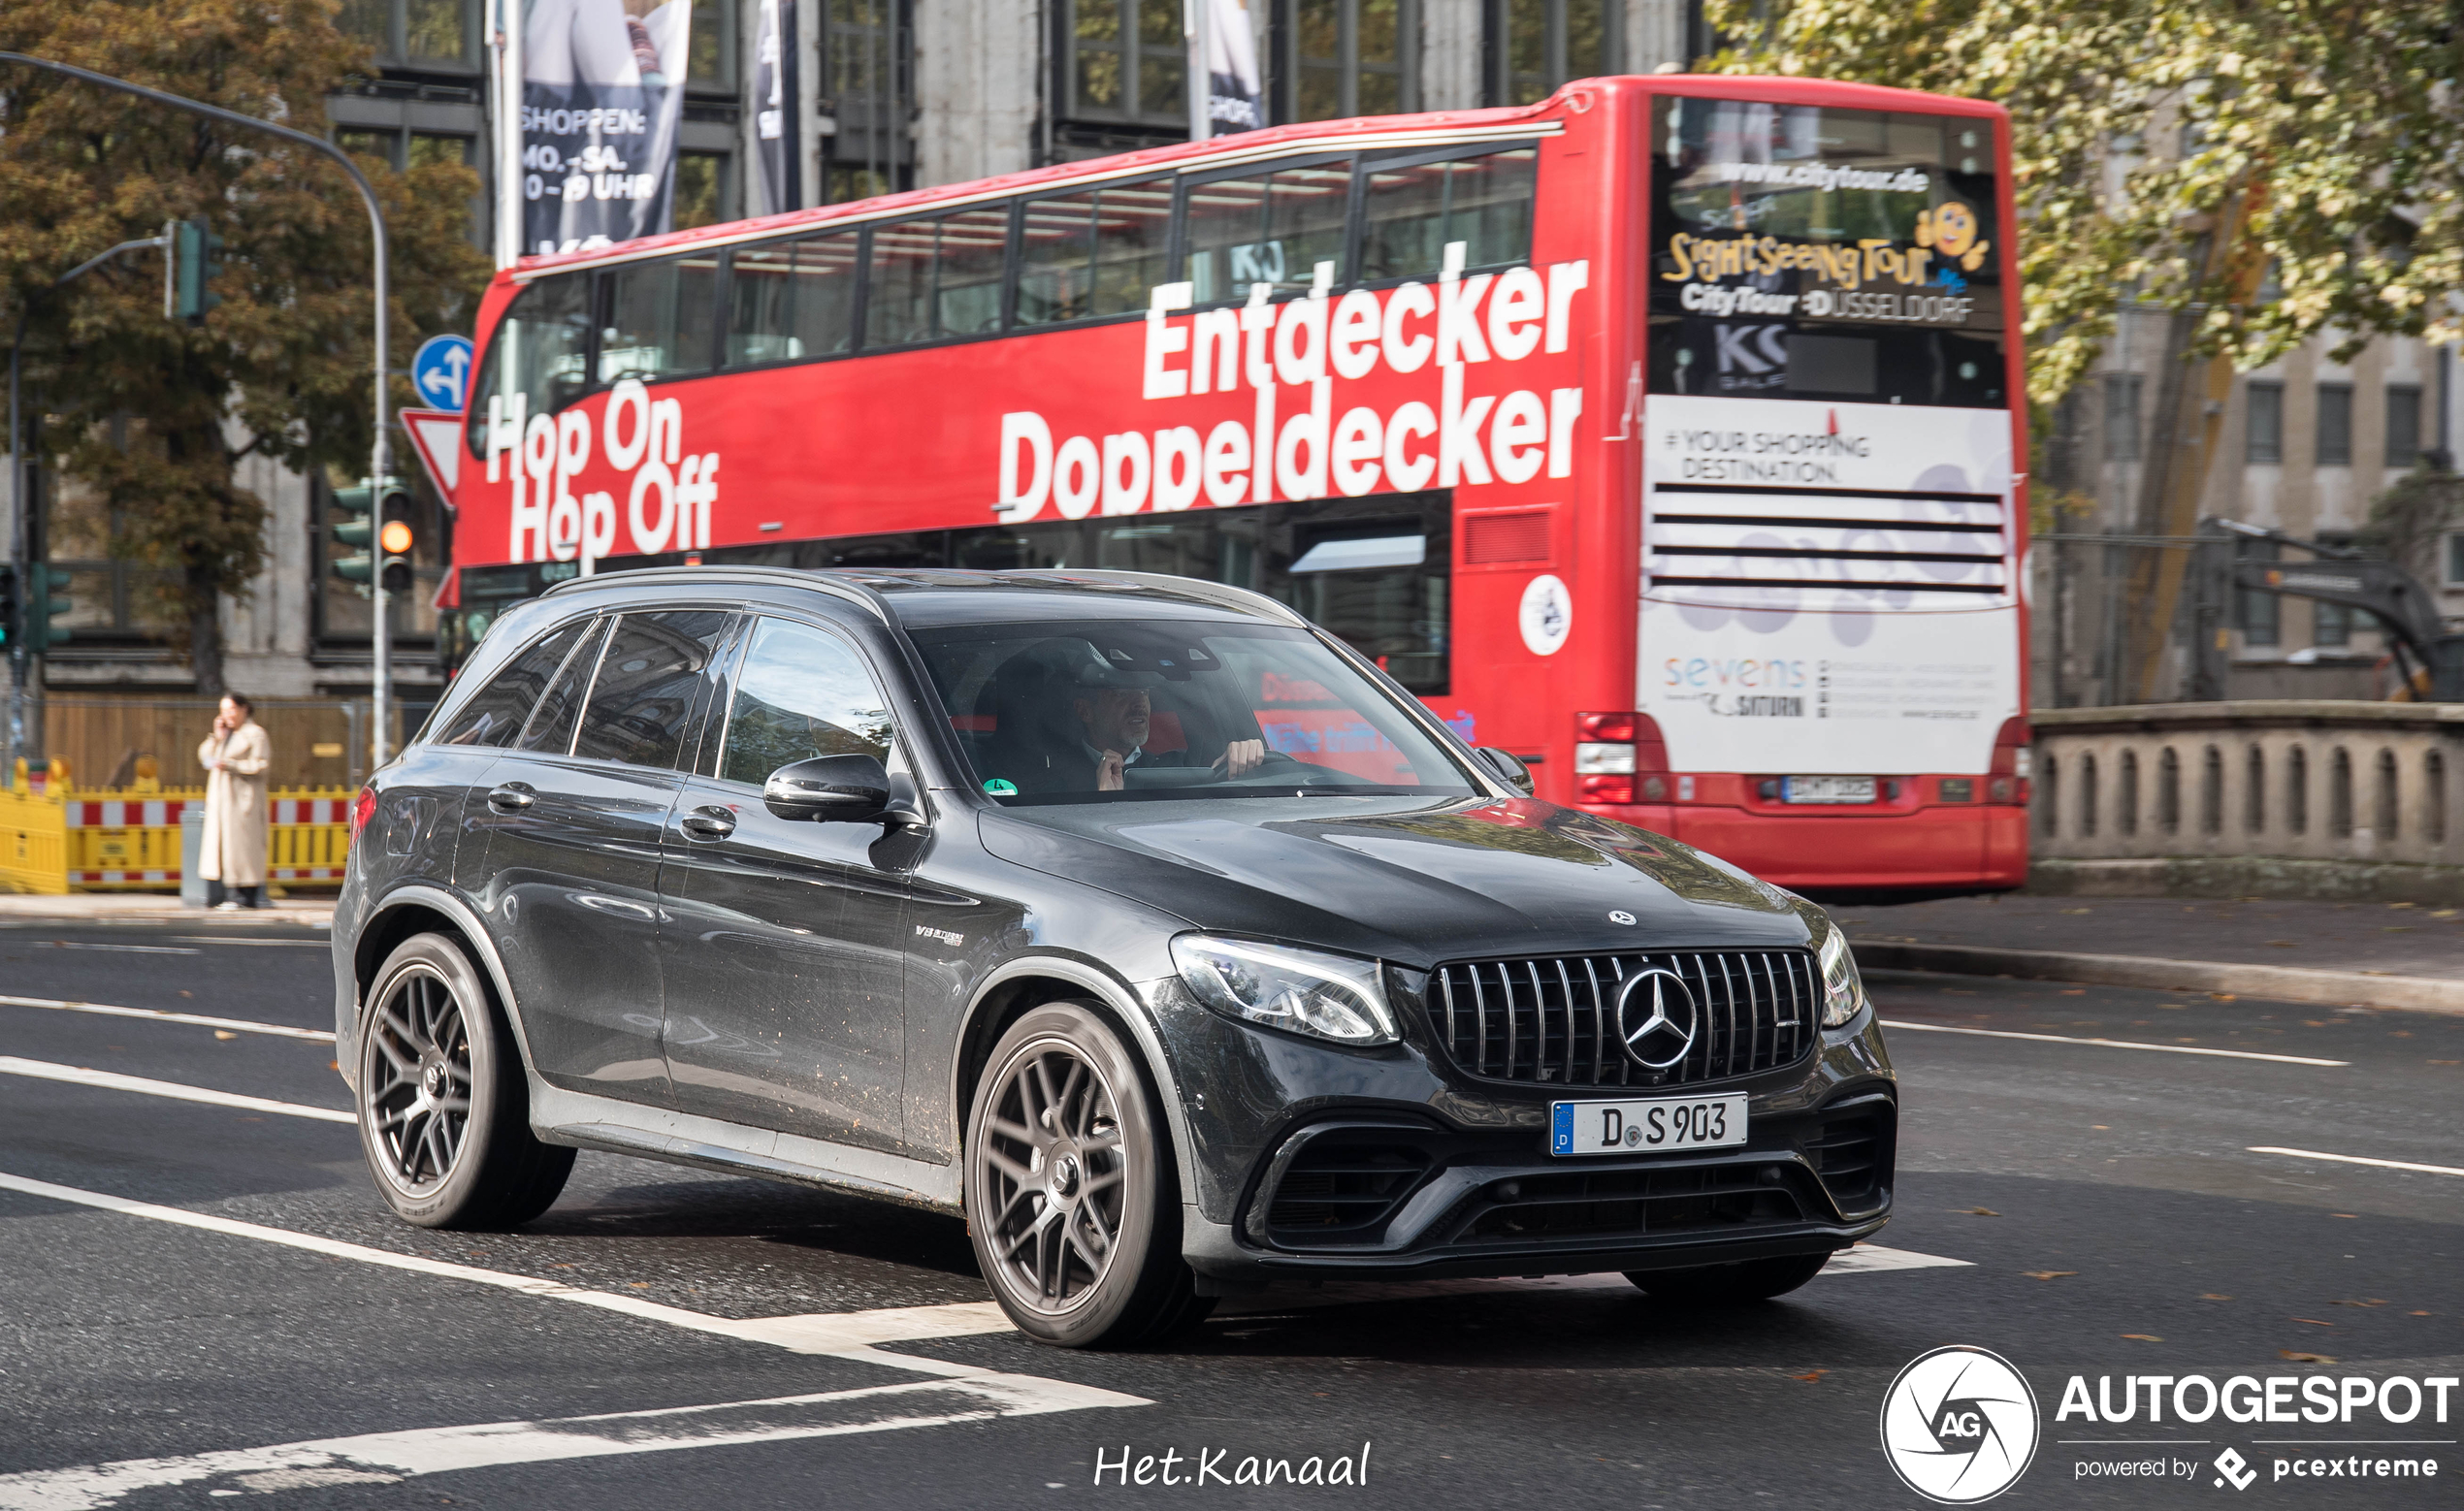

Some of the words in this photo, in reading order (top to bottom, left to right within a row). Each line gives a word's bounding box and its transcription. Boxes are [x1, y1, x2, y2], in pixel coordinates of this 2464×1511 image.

[521, 106, 647, 135] SHOPPEN:
[593, 174, 655, 200] UHR
[1721, 162, 1929, 193] www.citytour.de
[1144, 241, 1589, 400] Entdecker
[487, 393, 591, 499] Hop
[603, 378, 682, 471] On
[999, 361, 1582, 525] Doppeldecker
[1682, 431, 1746, 452] YOUR
[1754, 433, 1870, 457] SHOPPING
[510, 475, 616, 578] Hop
[629, 453, 720, 555] Off
[1665, 658, 1806, 687] sevens
[916, 925, 934, 938] V8
[1559, 1134, 1568, 1145] D
[1602, 1109, 1622, 1146] D
